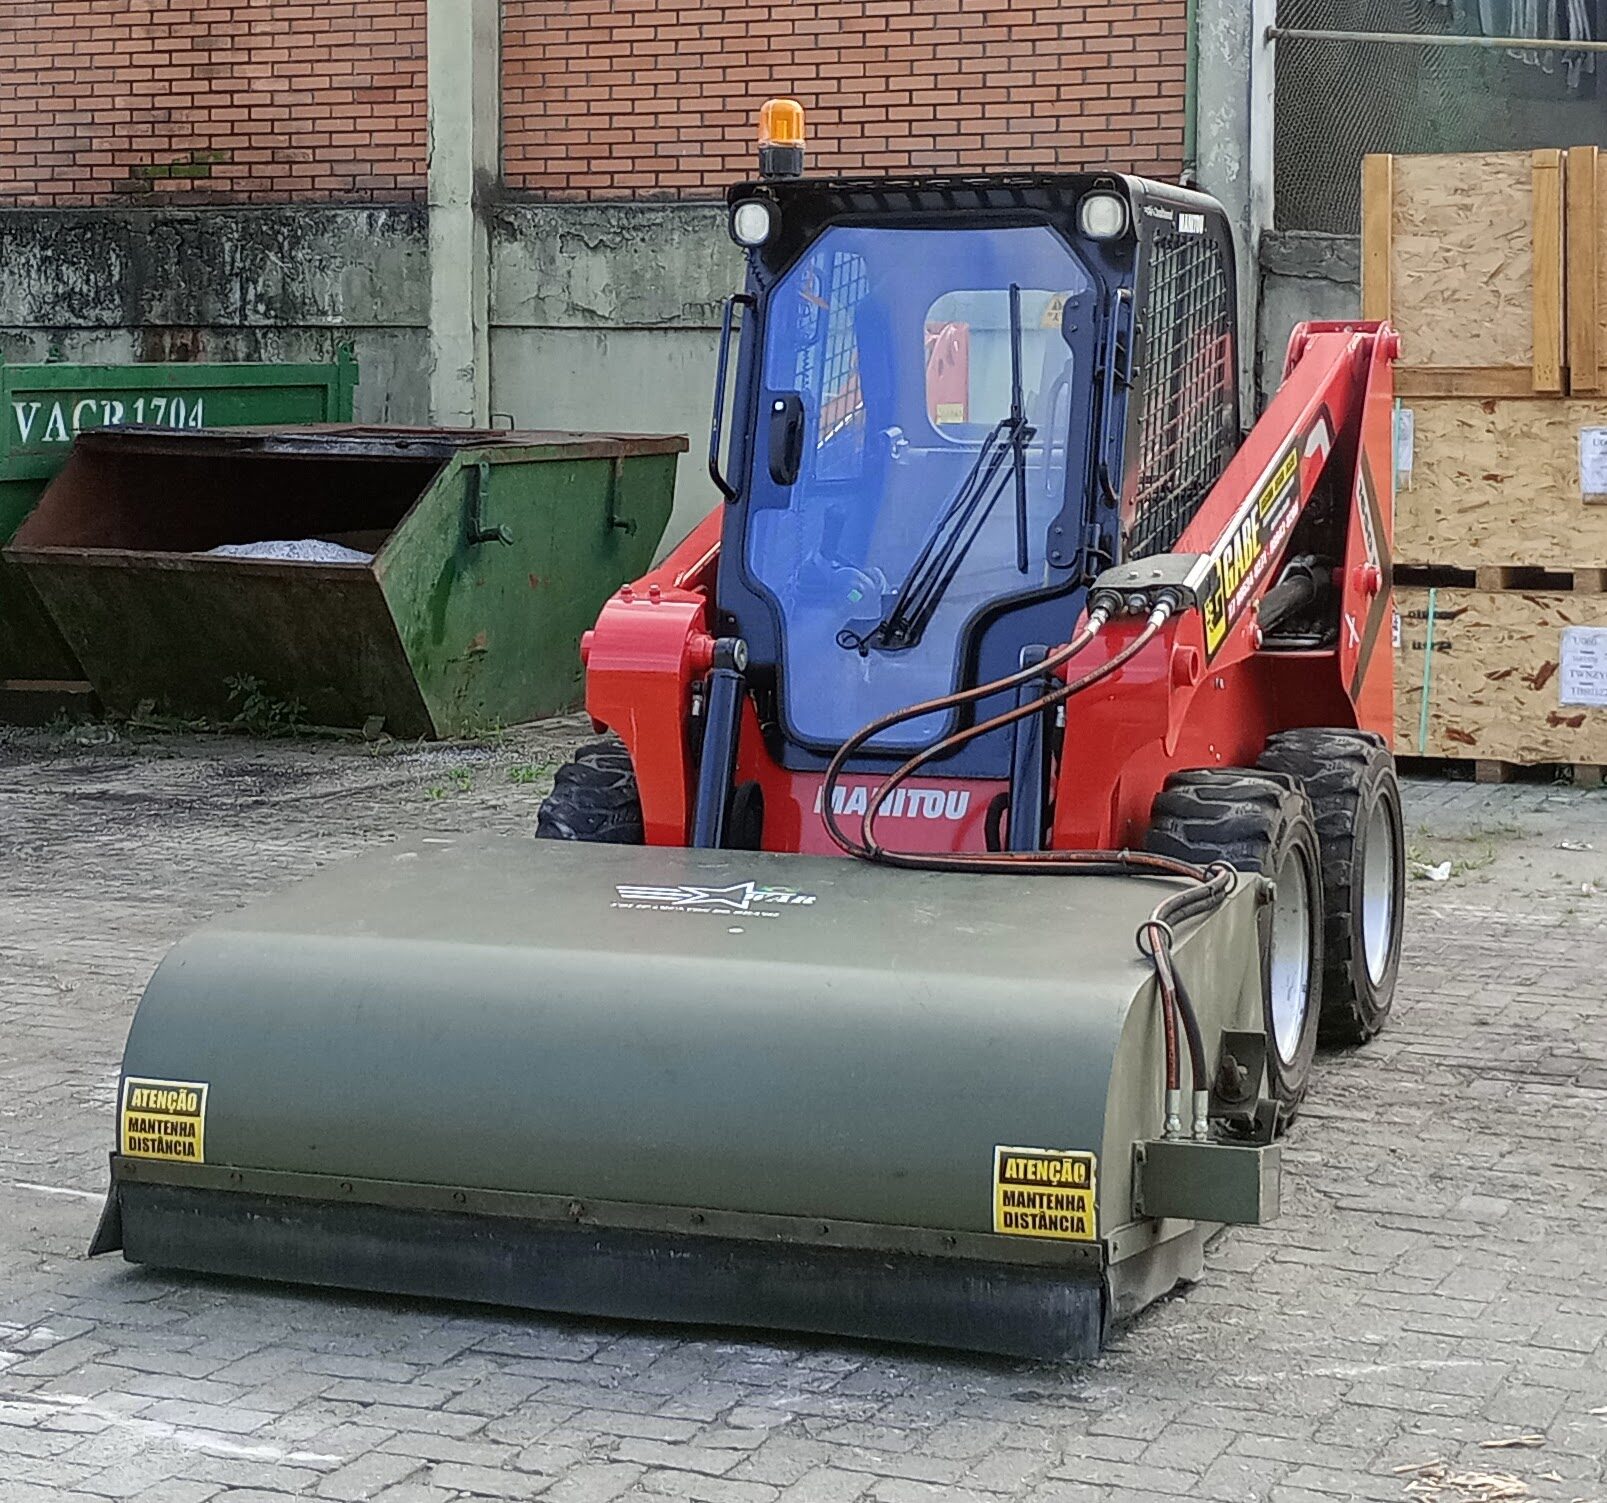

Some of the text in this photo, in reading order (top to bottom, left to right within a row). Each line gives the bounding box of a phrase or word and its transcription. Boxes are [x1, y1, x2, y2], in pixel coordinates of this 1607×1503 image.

[131, 1088, 197, 1114] ATENÇÃO
[128, 1116, 196, 1139] MANTENHA
[128, 1135, 196, 1157] DISTÂNCIA
[1004, 1157, 1087, 1186] ATENÇÃO
[1002, 1189, 1087, 1213] MANTENHA
[1003, 1211, 1086, 1234] DISTÂNCIA
